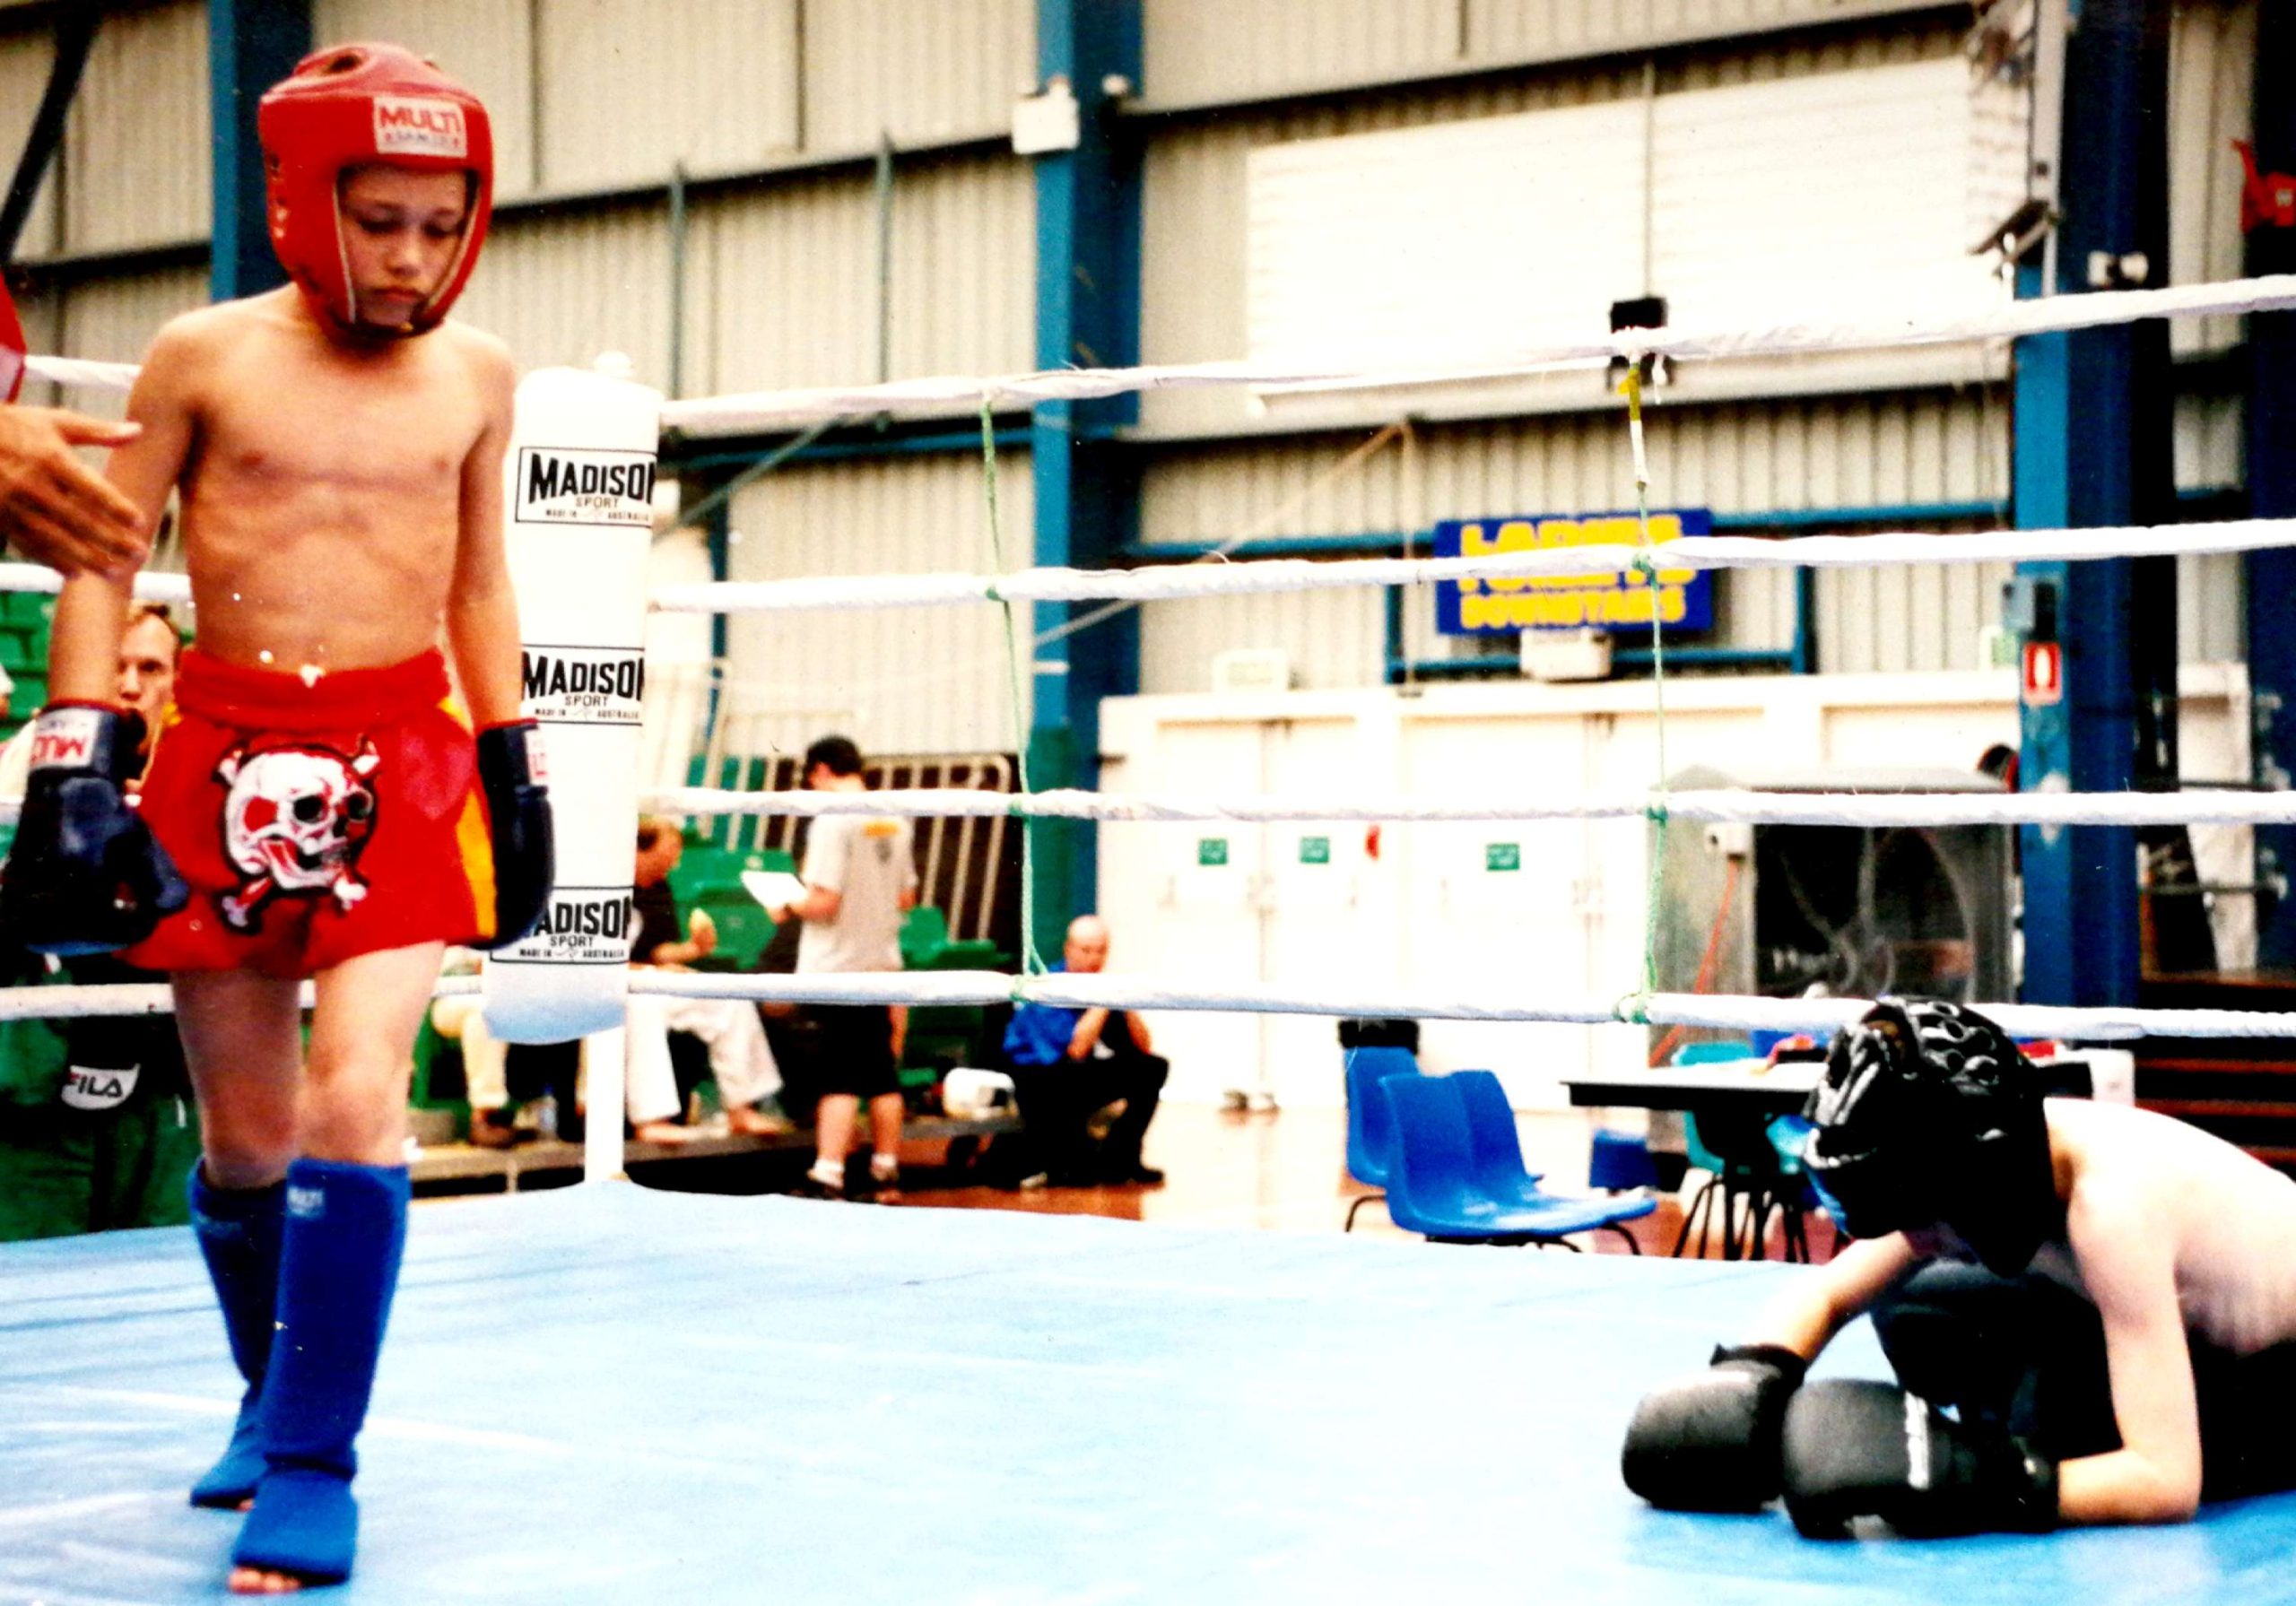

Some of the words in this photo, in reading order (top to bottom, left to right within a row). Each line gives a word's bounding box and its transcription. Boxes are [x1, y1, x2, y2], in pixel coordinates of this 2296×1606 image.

[379, 106, 461, 134] MULTI
[576, 497, 619, 508] SPORT
[565, 696, 609, 707] SPORT
[534, 896, 631, 940] ADISO
[550, 936, 594, 947] SPORT
[69, 1072, 123, 1098] FILA
